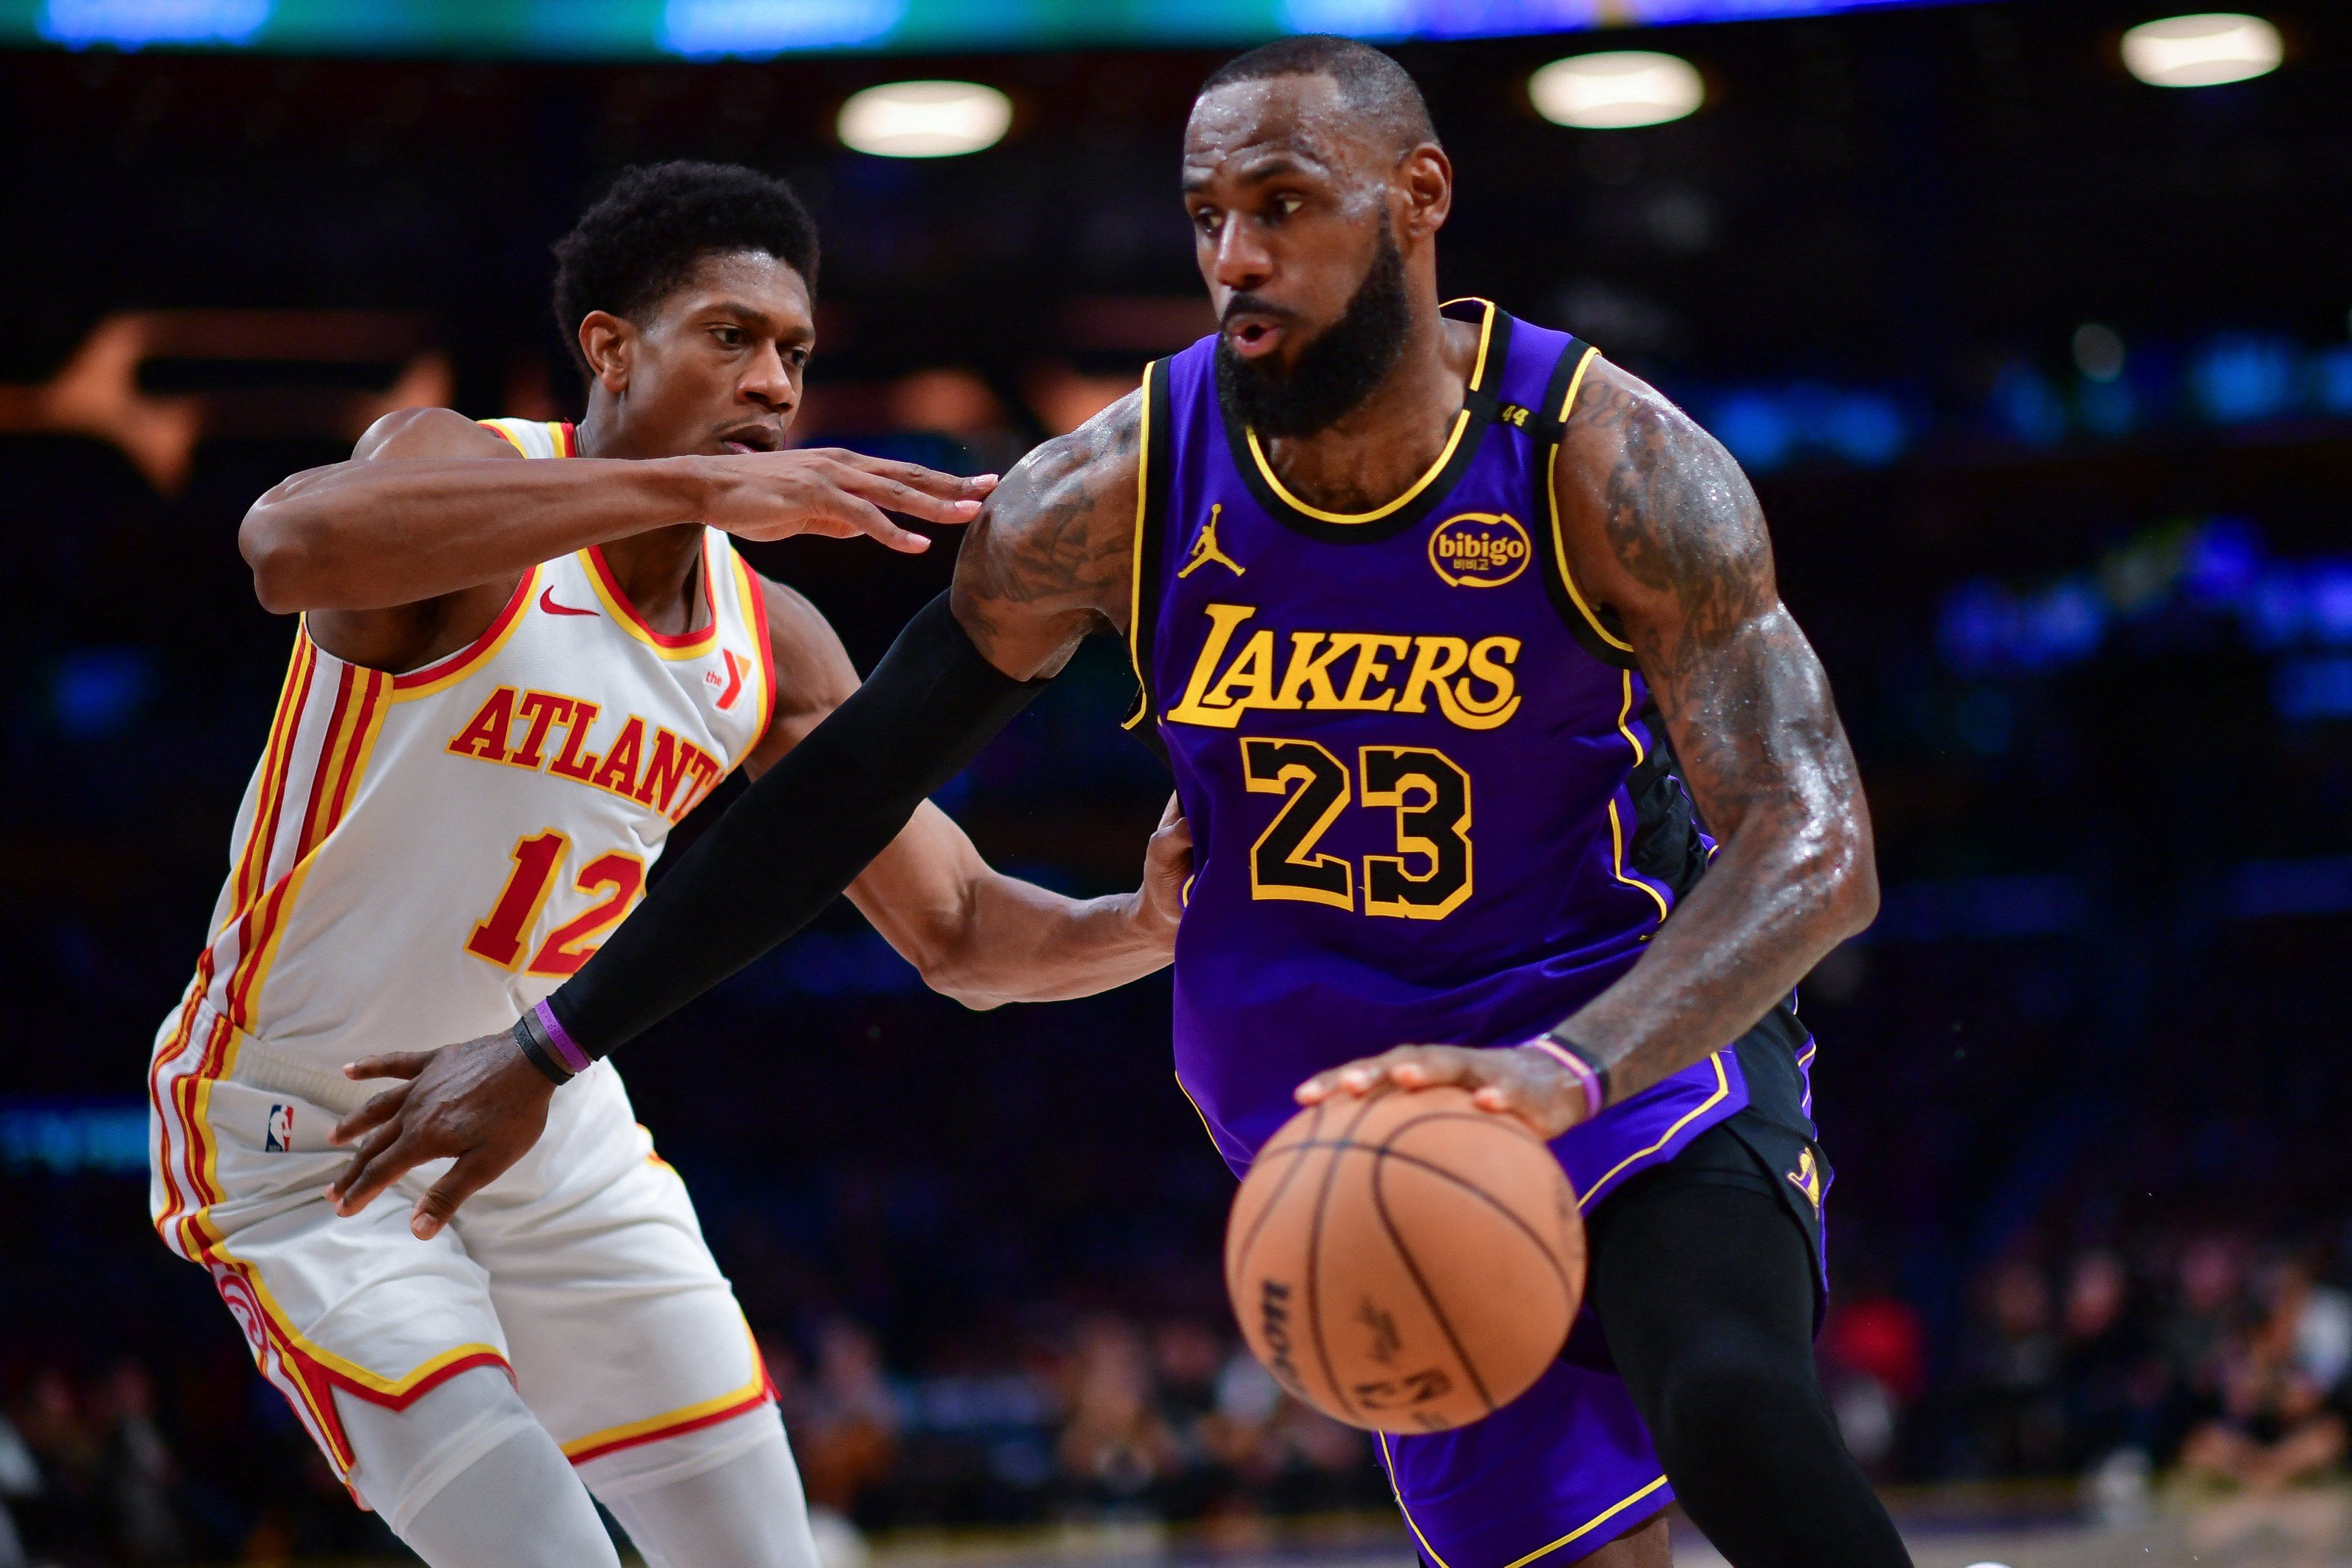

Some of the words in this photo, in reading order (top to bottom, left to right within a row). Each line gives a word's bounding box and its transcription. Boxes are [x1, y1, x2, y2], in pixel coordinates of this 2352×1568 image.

[1439, 532, 1525, 566] bibigo
[705, 670, 723, 687] the
[1166, 603, 1522, 730] LAKERS
[444, 684, 727, 827] ATLANT
[1239, 736, 1473, 920] 23
[462, 827, 647, 977] 12
